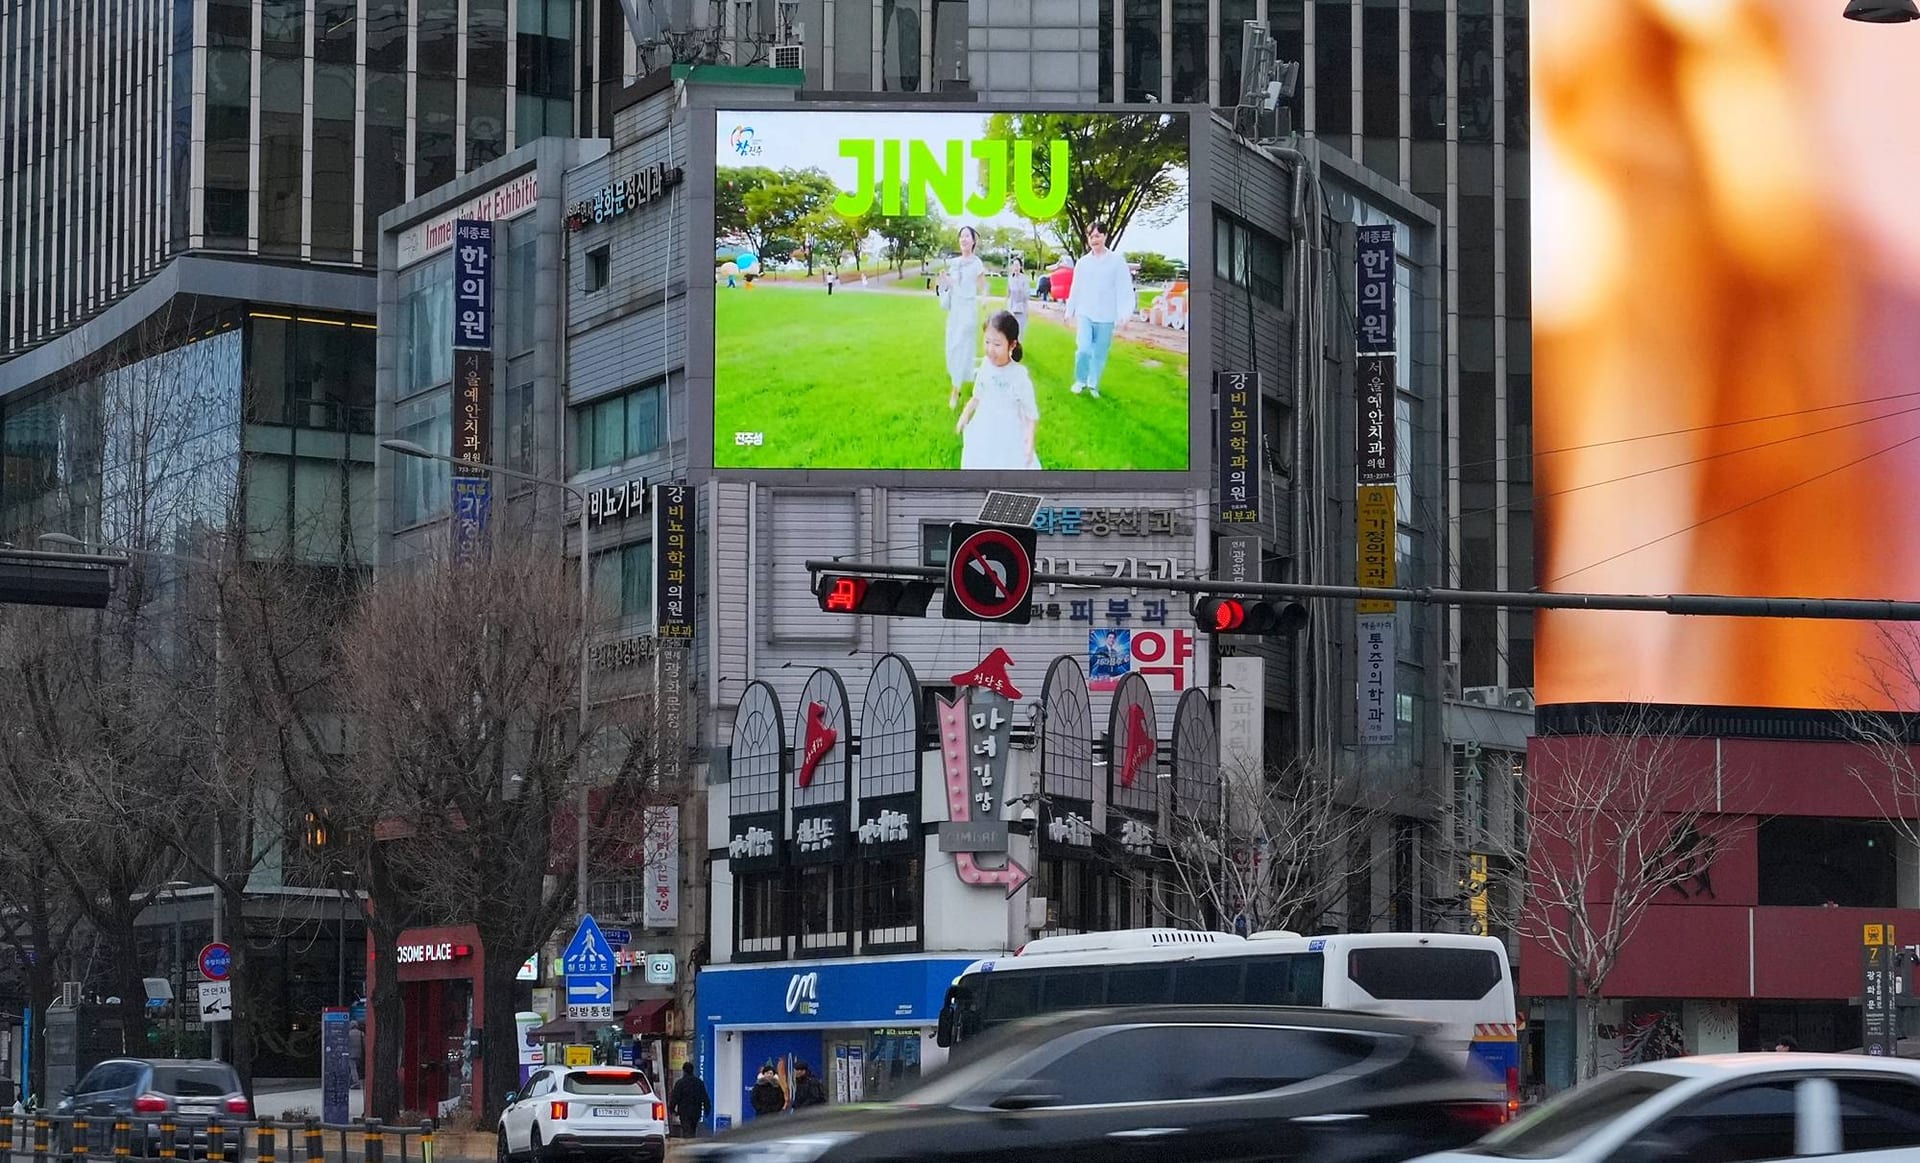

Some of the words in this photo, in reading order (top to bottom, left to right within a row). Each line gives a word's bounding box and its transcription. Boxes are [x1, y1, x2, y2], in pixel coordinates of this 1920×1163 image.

[833, 138, 1070, 218] JINJU
[458, 226, 490, 239] 세종로
[1359, 230, 1392, 244] 세종로
[460, 245, 487, 340] 한의원
[1361, 249, 1389, 344] 한의원
[464, 355, 481, 451] 서울예안치과
[735, 431, 763, 446] 진주성
[1230, 373, 1248, 502] 강비뇨의학과의원
[1367, 458, 1385, 468] 의원
[591, 477, 645, 525] 비뇨기과
[1222, 510, 1257, 522] 피부과
[667, 486, 685, 617] 강비뇨의학과의원
[1366, 519, 1387, 580] 가정의학과
[1070, 599, 1168, 626] 피부과
[660, 625, 691, 637] 피부과
[1131, 630, 1193, 691] 약
[1368, 633, 1385, 723] 통증의학과
[971, 708, 1005, 812] 마녀김밥
[425, 943, 452, 961] PLACE
[568, 963, 608, 972] 횡단보도
[655, 963, 669, 972] CU
[1870, 947, 1878, 960] 7
[1866, 971, 1876, 1010] 광화문
[569, 1006, 611, 1018] 일방통행
